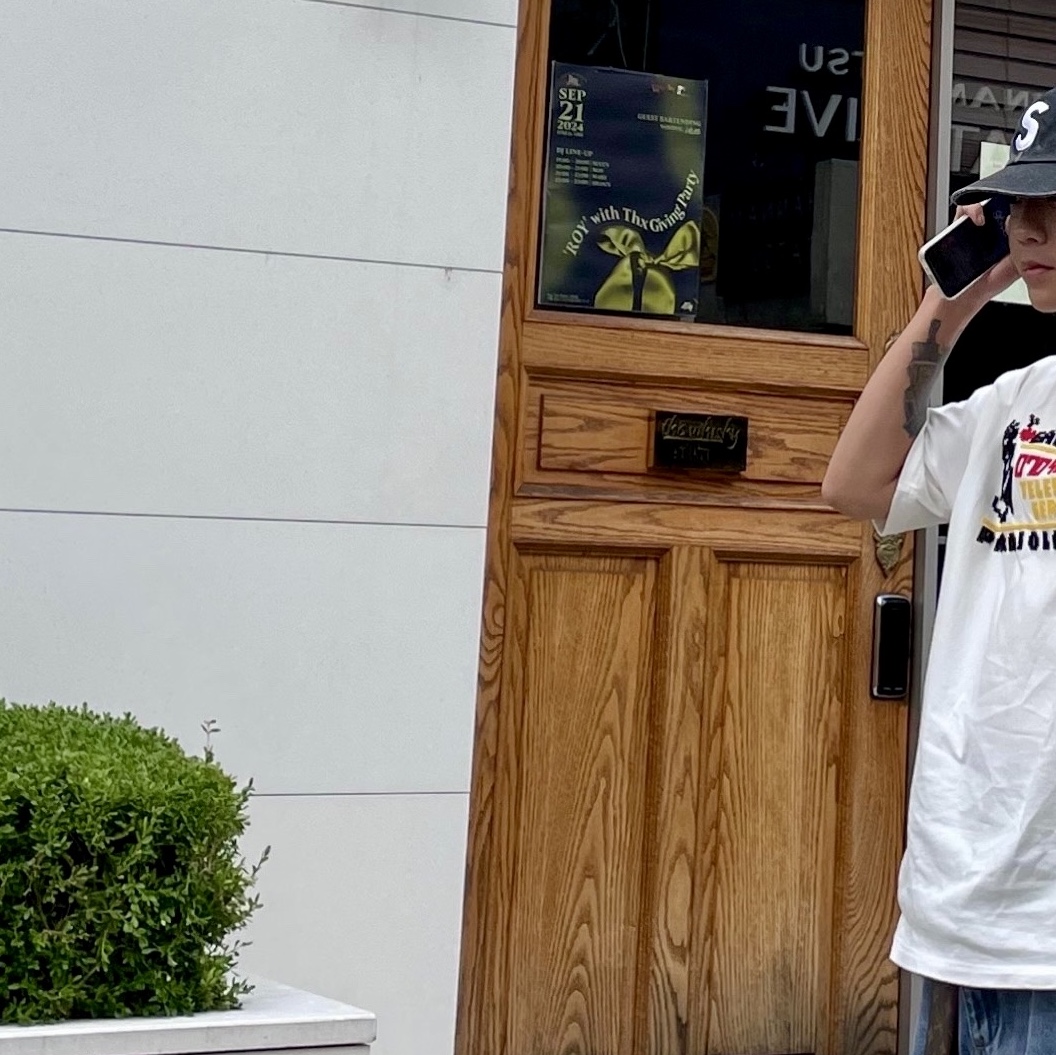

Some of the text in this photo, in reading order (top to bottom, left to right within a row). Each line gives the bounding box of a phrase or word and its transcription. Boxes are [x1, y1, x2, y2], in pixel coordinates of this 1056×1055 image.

[558, 87, 587, 101] SEP
[558, 100, 584, 123] 21
[556, 120, 584, 132] 2024
[1015, 101, 1050, 152] S
[590, 205, 620, 225] with
[622, 207, 650, 231] Thx
[649, 203, 686, 232] Giving
[677, 169, 700, 209] Party
